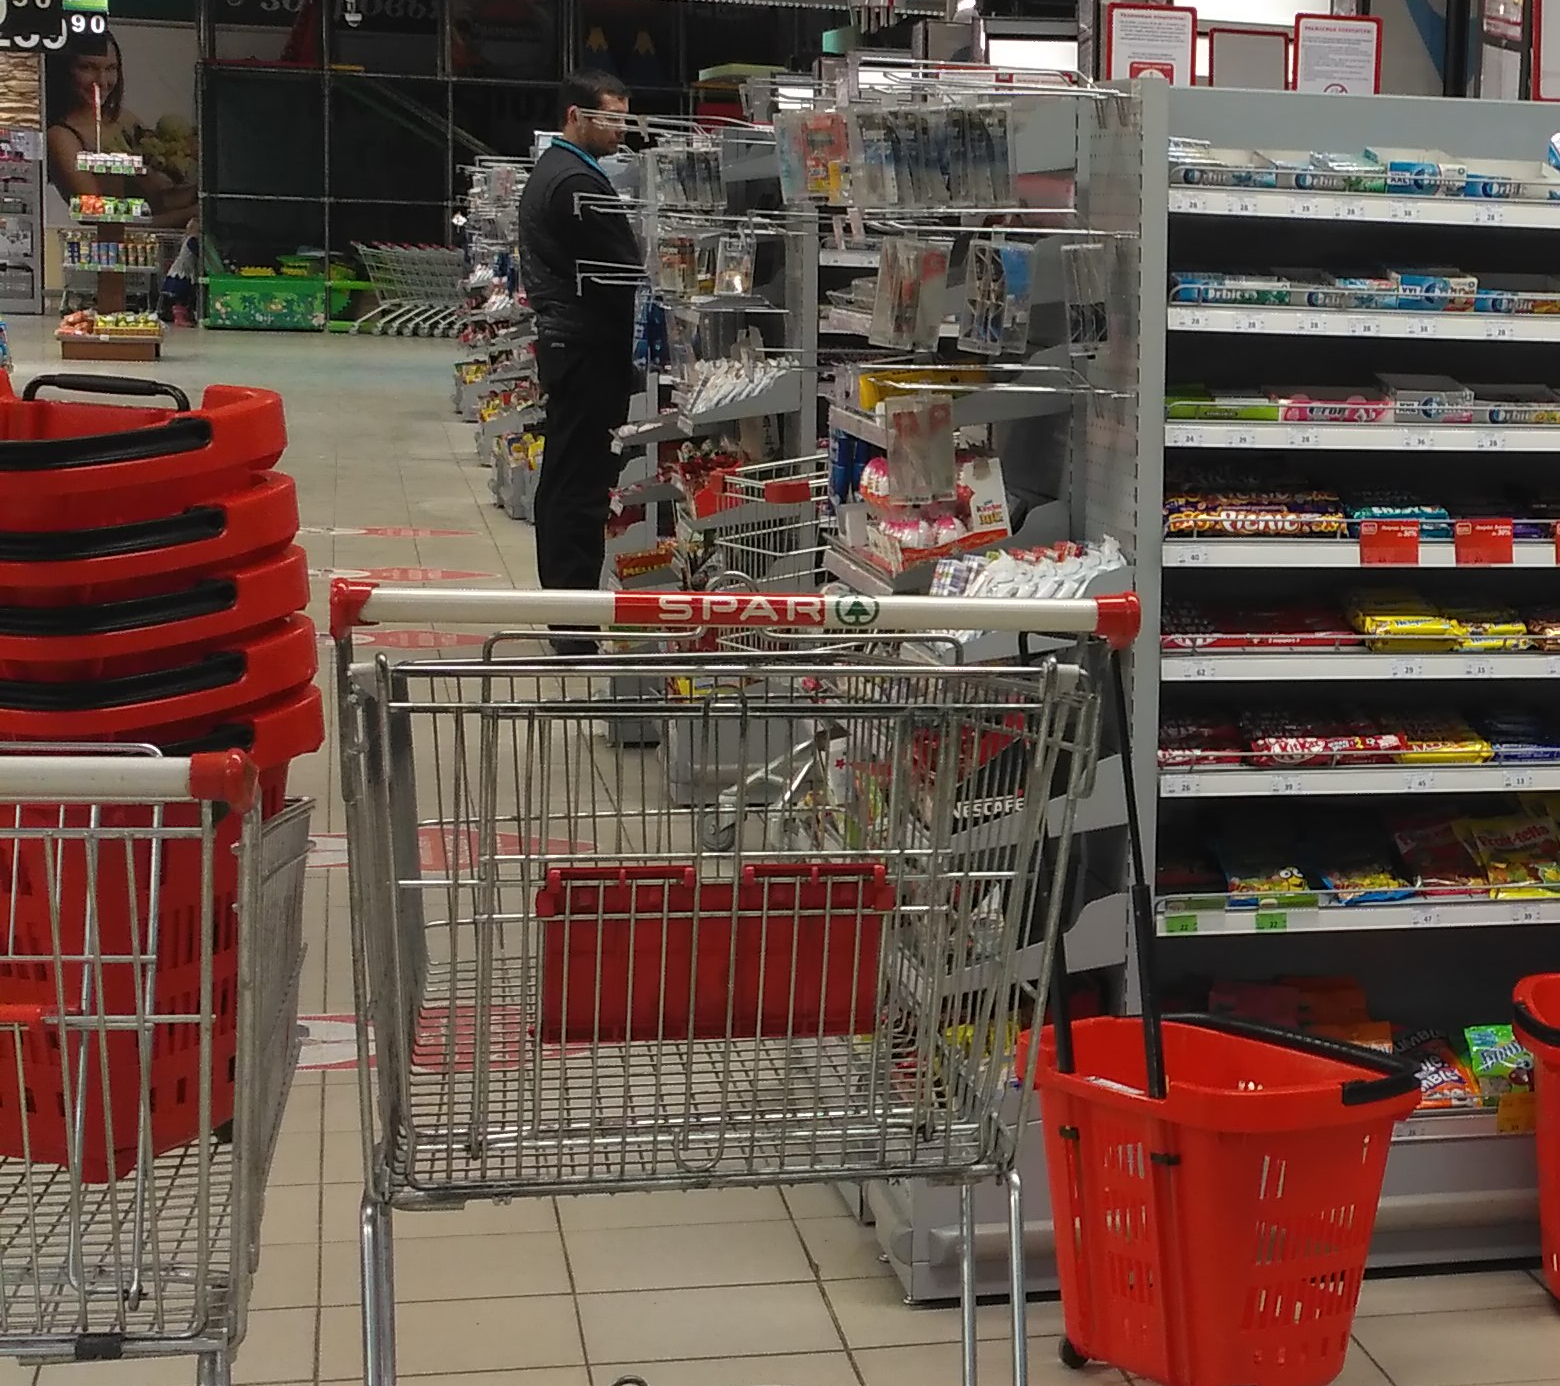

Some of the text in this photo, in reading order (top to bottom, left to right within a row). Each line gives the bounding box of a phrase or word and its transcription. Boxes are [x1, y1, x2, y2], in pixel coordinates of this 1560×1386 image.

[71, 14, 106, 34] 90
[1219, 510, 1299, 532] Picnic
[658, 596, 825, 623] SPAR
